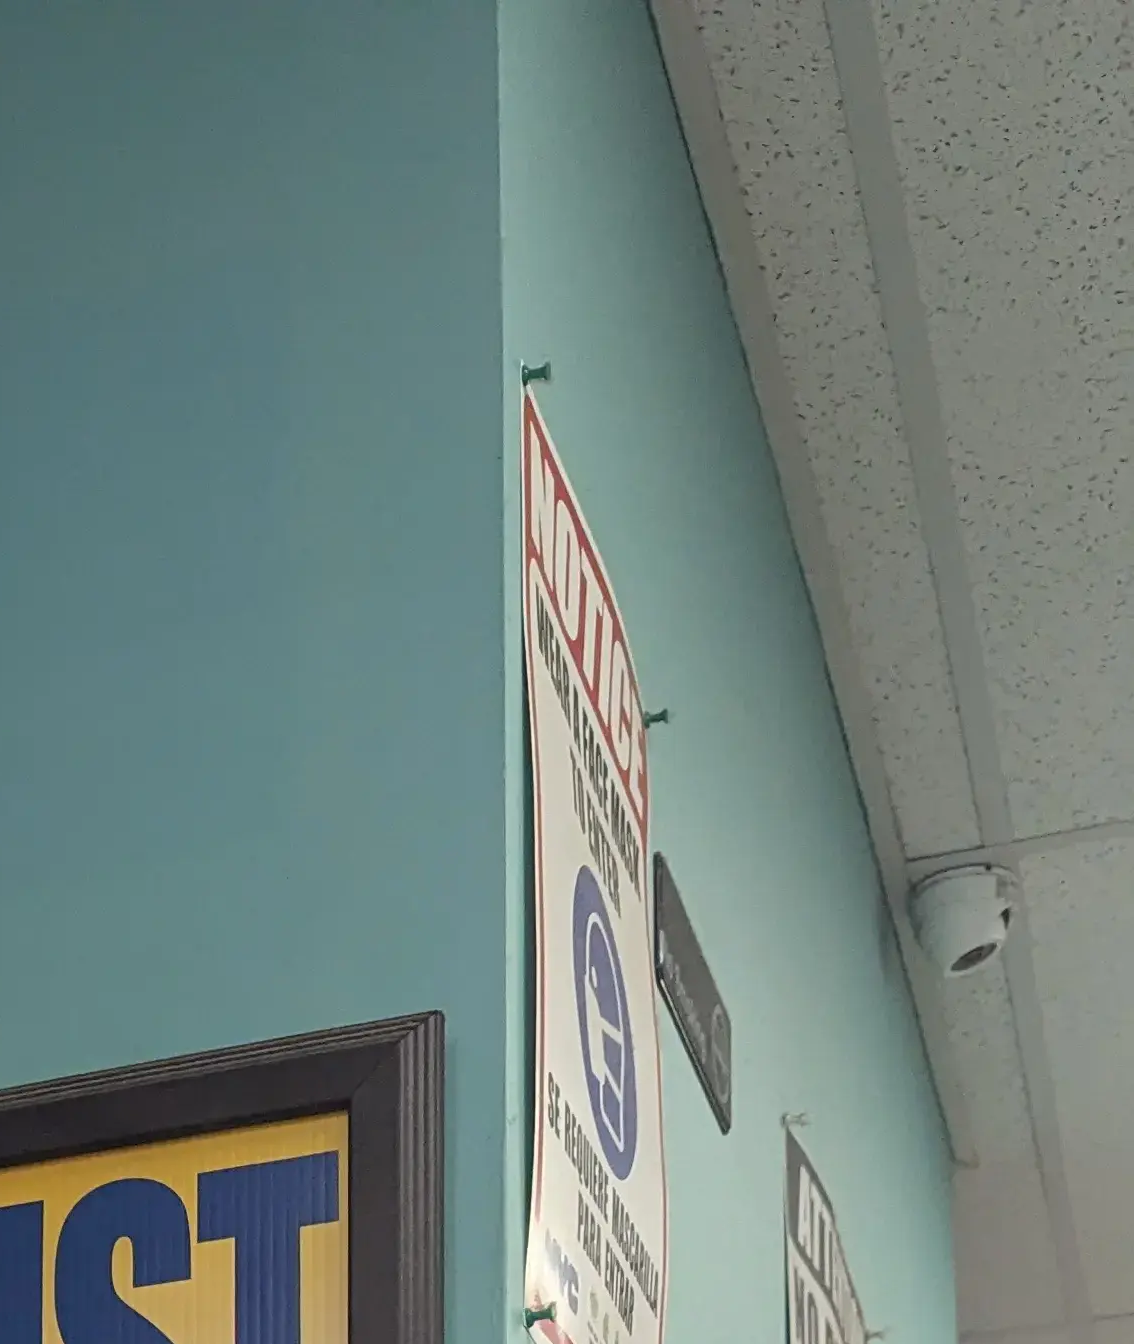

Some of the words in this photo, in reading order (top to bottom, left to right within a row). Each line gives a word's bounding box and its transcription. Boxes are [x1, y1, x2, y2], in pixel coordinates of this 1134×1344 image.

[530, 420, 645, 814] NOTICE
[535, 580, 571, 730] WEAR
[573, 688, 580, 755] A
[582, 716, 609, 820] FACE
[610, 780, 641, 902] MASK
[569, 745, 586, 835] TO
[588, 796, 622, 918] ENTER
[547, 1071, 561, 1140] SE
[564, 1098, 609, 1225] REQUIERE
[611, 1185, 658, 1319] MASCARILLA
[577, 1190, 602, 1278] PARA
[605, 1241, 635, 1337] ENTRAR
